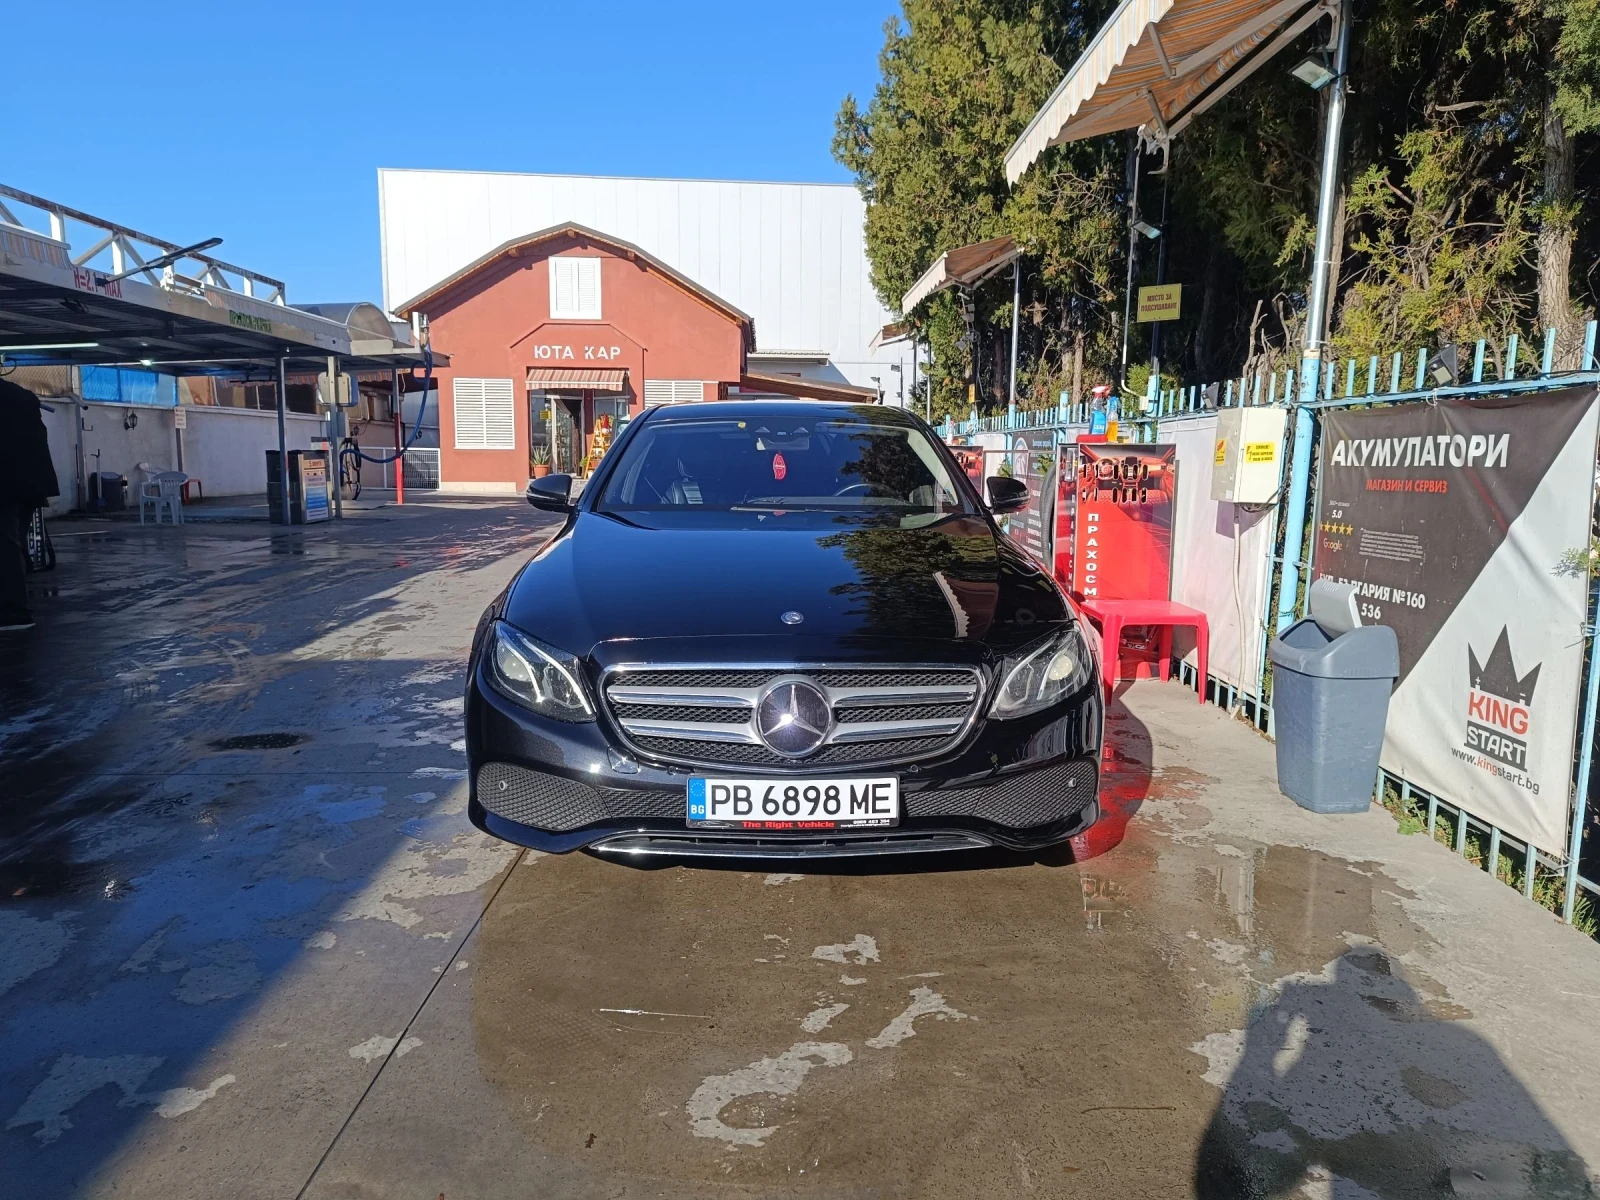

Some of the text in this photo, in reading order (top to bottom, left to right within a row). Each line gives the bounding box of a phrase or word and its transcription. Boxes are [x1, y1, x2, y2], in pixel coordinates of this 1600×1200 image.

[1165, 293, 1172, 301] ЗА
[1141, 302, 1177, 312] ПОДСУШАВАНЕ
[534, 345, 621, 360] ЮТА КАР
[1330, 433, 1510, 468] АКУМУЛАТОРИ
[1365, 479, 1448, 493] МАГАЗИН И СЕРВИЗ
[1331, 509, 1343, 519] 5.0
[1323, 538, 1343, 552] Google
[1083, 513, 1100, 602] ПРАХОСМ
[1360, 603, 1381, 620] 536
[1468, 691, 1529, 735] KING
[1467, 726, 1526, 764] START
[1451, 747, 1540, 795] www.kingstart.bg
[711, 783, 891, 816] PB 6898 ME
[690, 804, 705, 814] BG
[742, 821, 761, 829] The
[764, 821, 794, 829] Right
[797, 821, 835, 829] Vehicle
